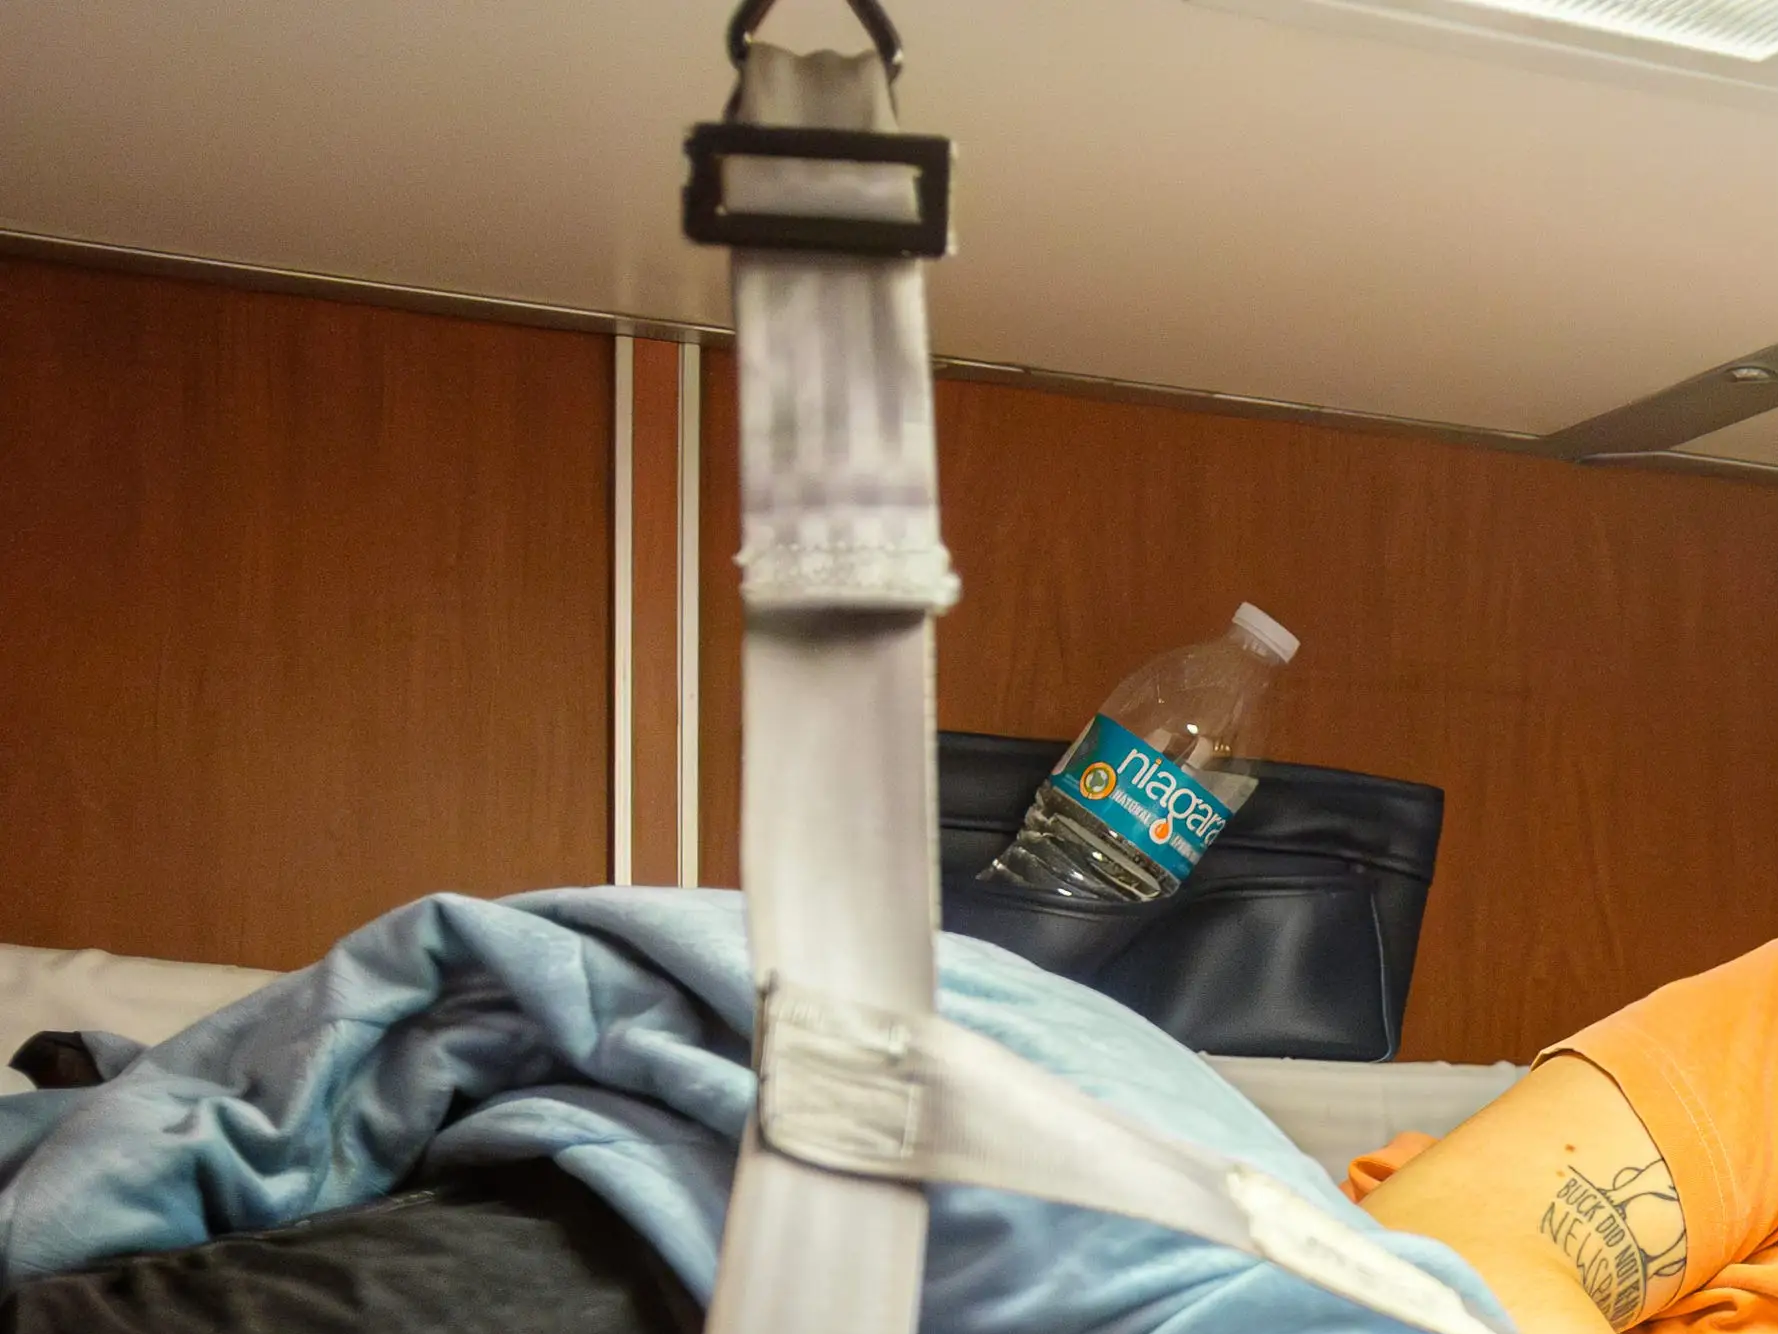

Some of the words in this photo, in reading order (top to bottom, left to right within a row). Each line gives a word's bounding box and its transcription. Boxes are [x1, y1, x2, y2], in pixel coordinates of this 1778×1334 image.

[1556, 1178, 1605, 1221] BUCK
[1595, 1214, 1626, 1248] DID
[1614, 1244, 1640, 1286] NOT
